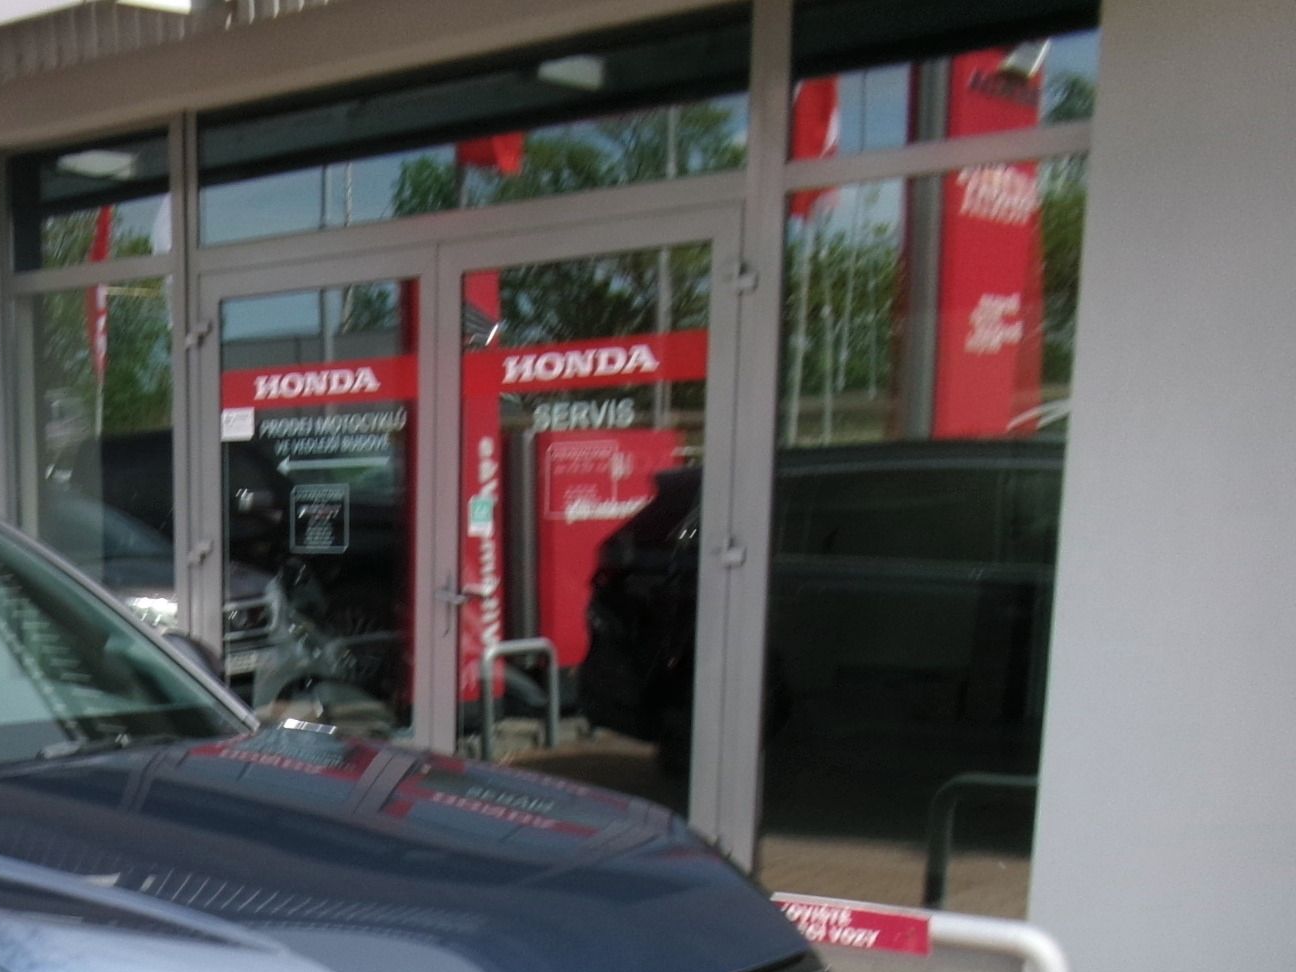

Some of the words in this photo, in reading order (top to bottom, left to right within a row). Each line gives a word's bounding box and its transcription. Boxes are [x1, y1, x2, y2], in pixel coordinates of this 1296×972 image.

[502, 343, 661, 385] HONDA
[253, 366, 382, 401] HONDA
[533, 397, 636, 432] SERVIS
[828, 926, 881, 948] VOZY
